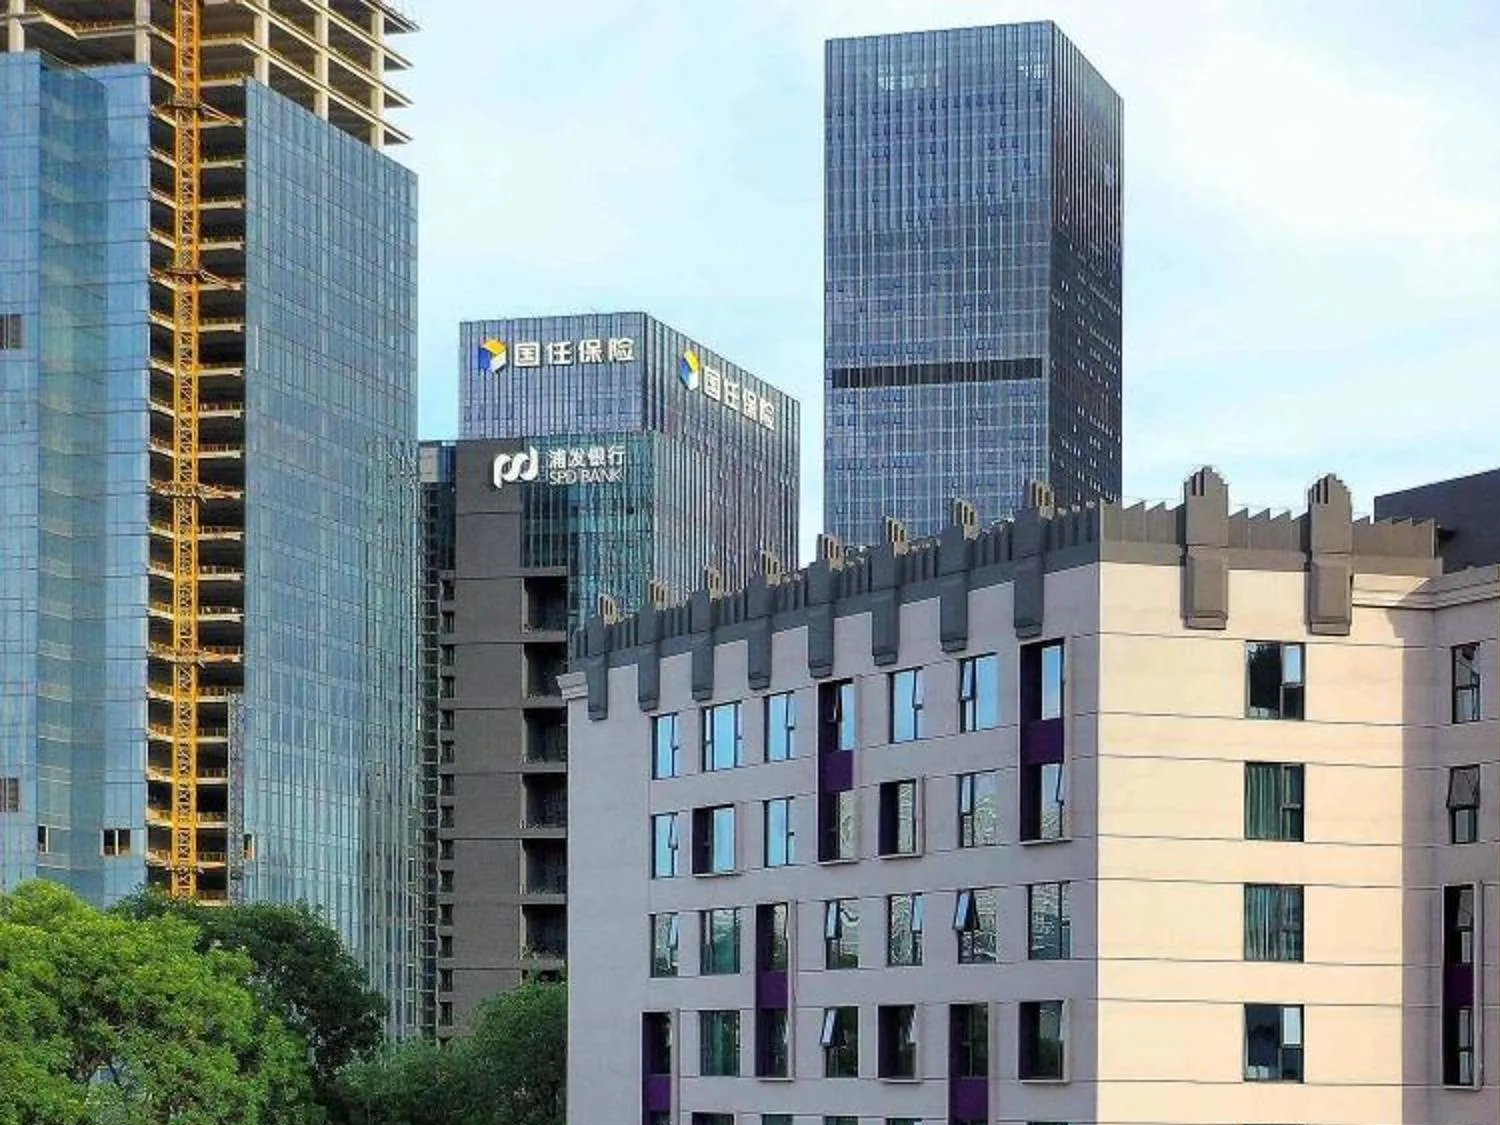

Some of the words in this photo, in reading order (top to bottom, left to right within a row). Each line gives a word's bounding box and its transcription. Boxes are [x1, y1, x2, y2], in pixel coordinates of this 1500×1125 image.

[514, 337, 635, 367] 国任保险
[703, 365, 775, 431] 国任保险
[549, 469, 577, 485] SPD
[581, 467, 624, 483] BANK
